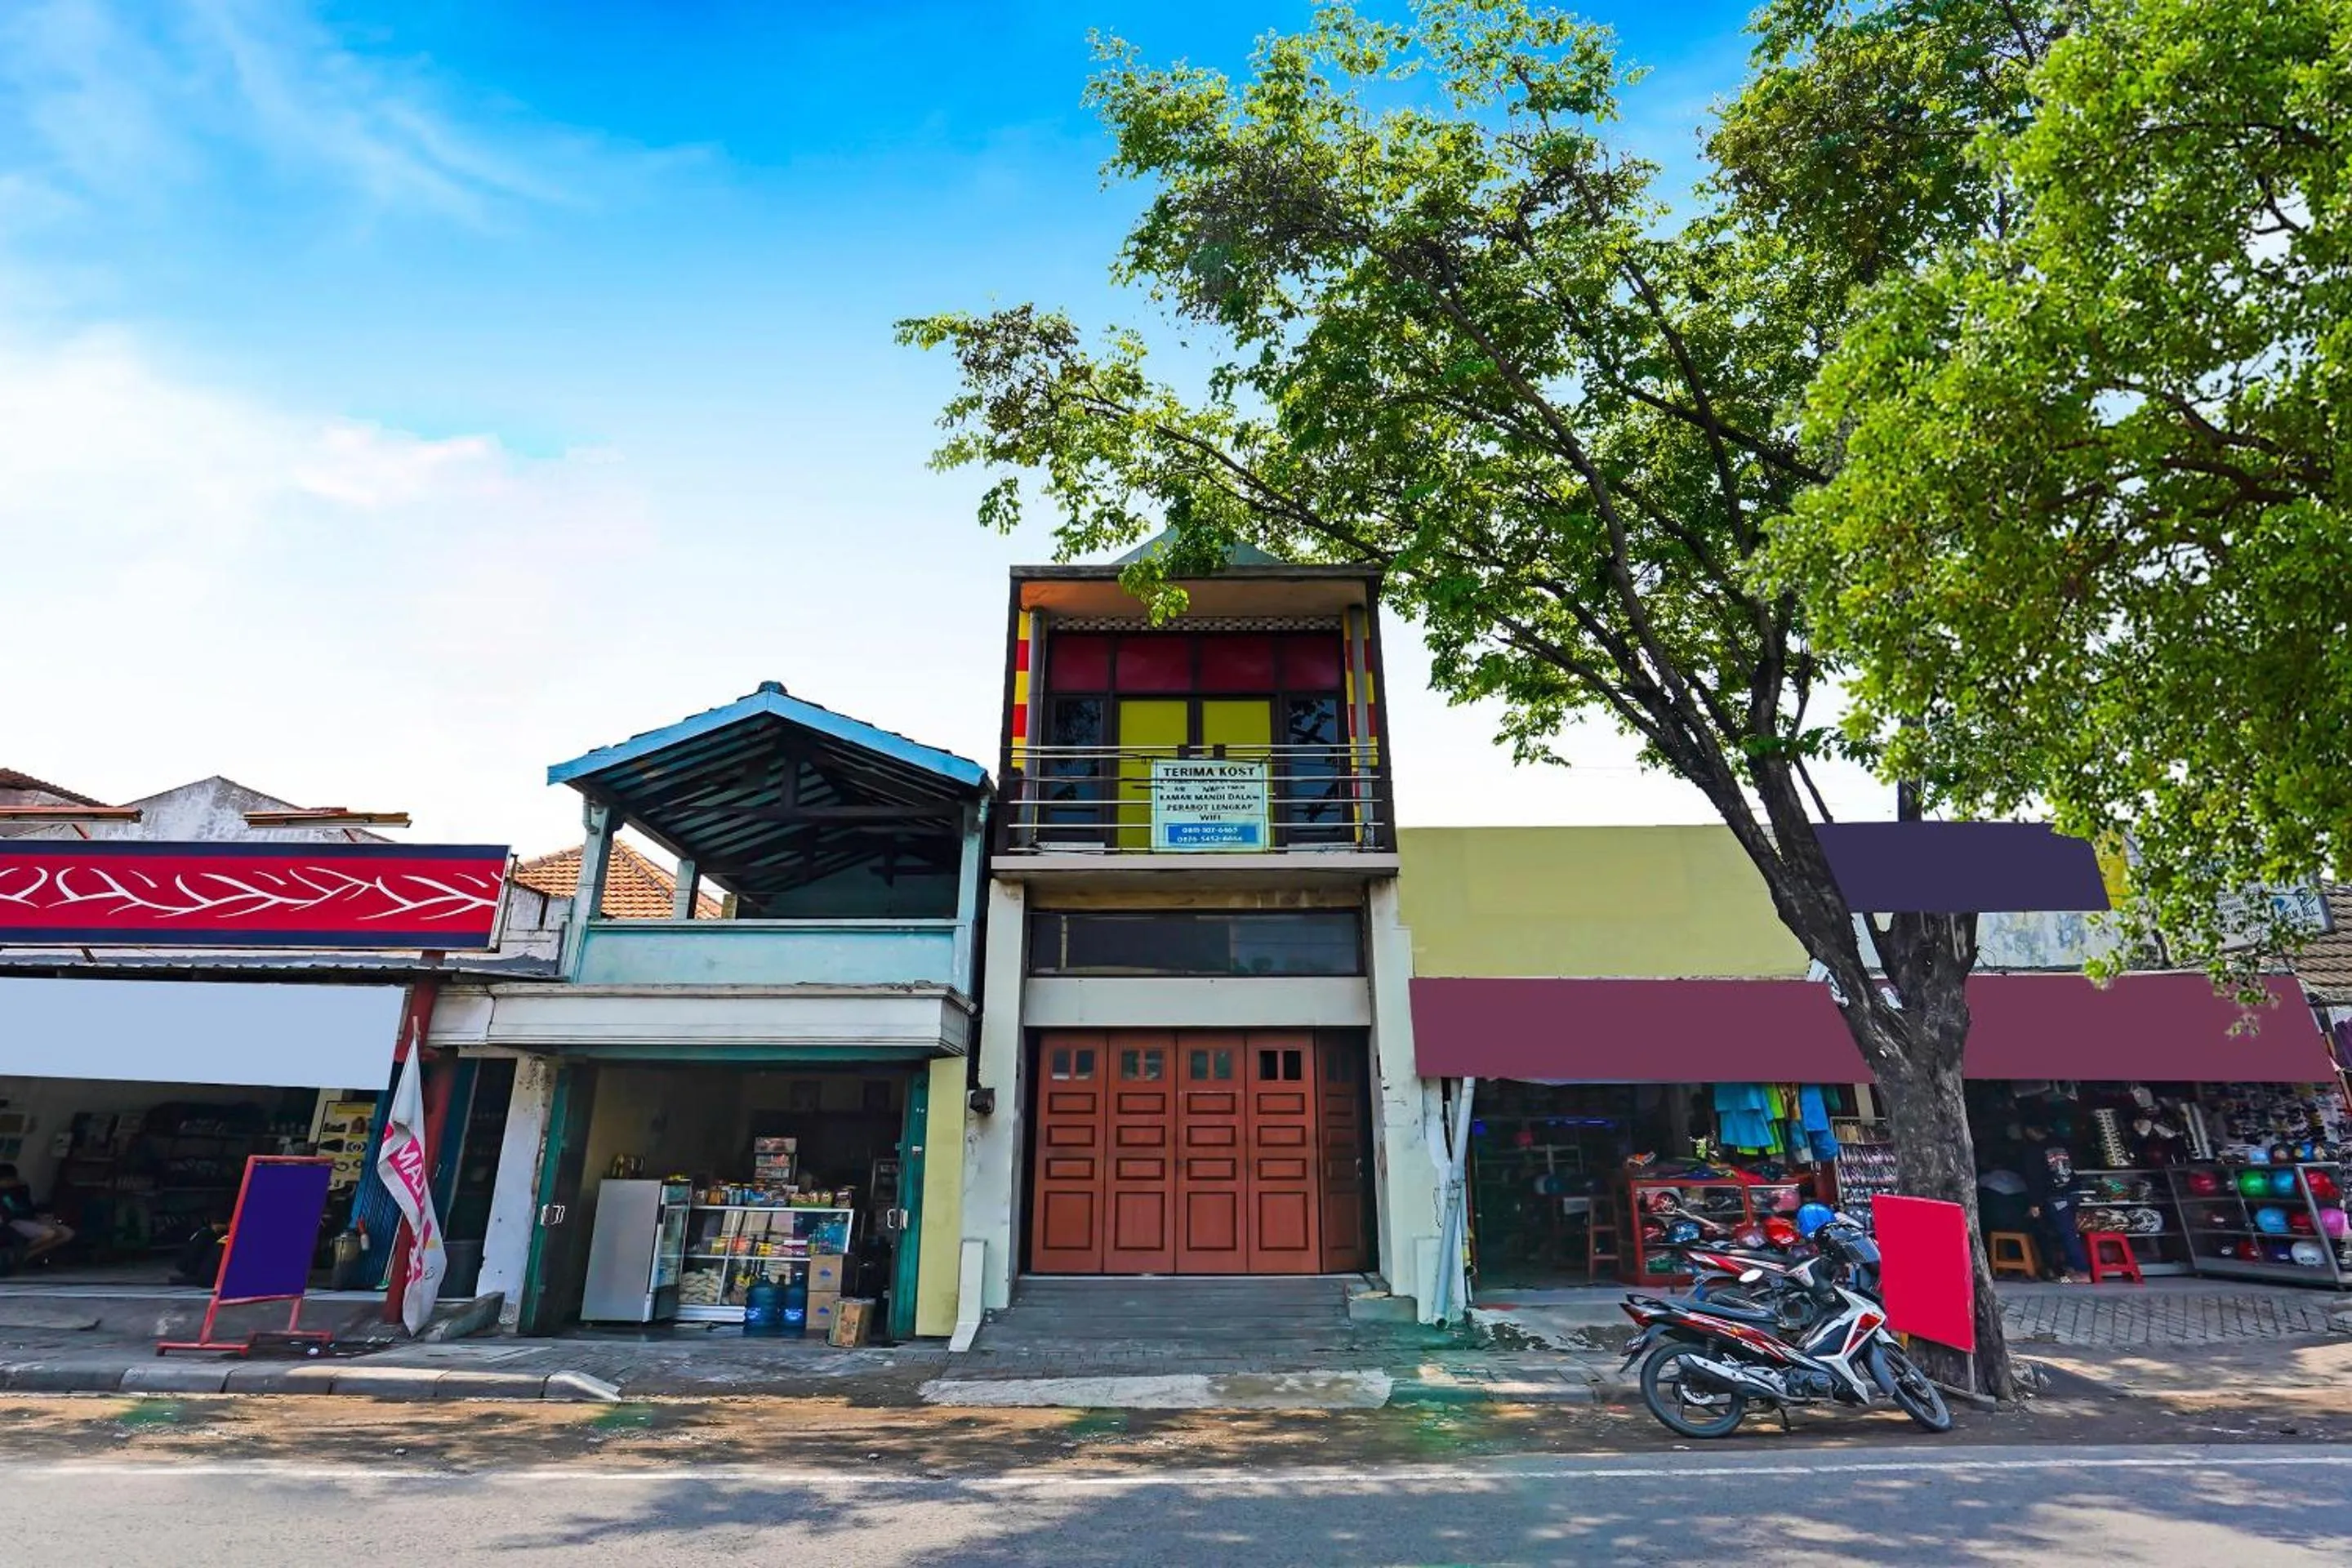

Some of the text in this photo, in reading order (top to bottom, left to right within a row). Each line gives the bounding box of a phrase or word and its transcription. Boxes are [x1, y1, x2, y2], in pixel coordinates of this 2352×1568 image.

[1164, 767, 1255, 777] TERIMA KOST
[1166, 804, 1209, 812] PERABOT
